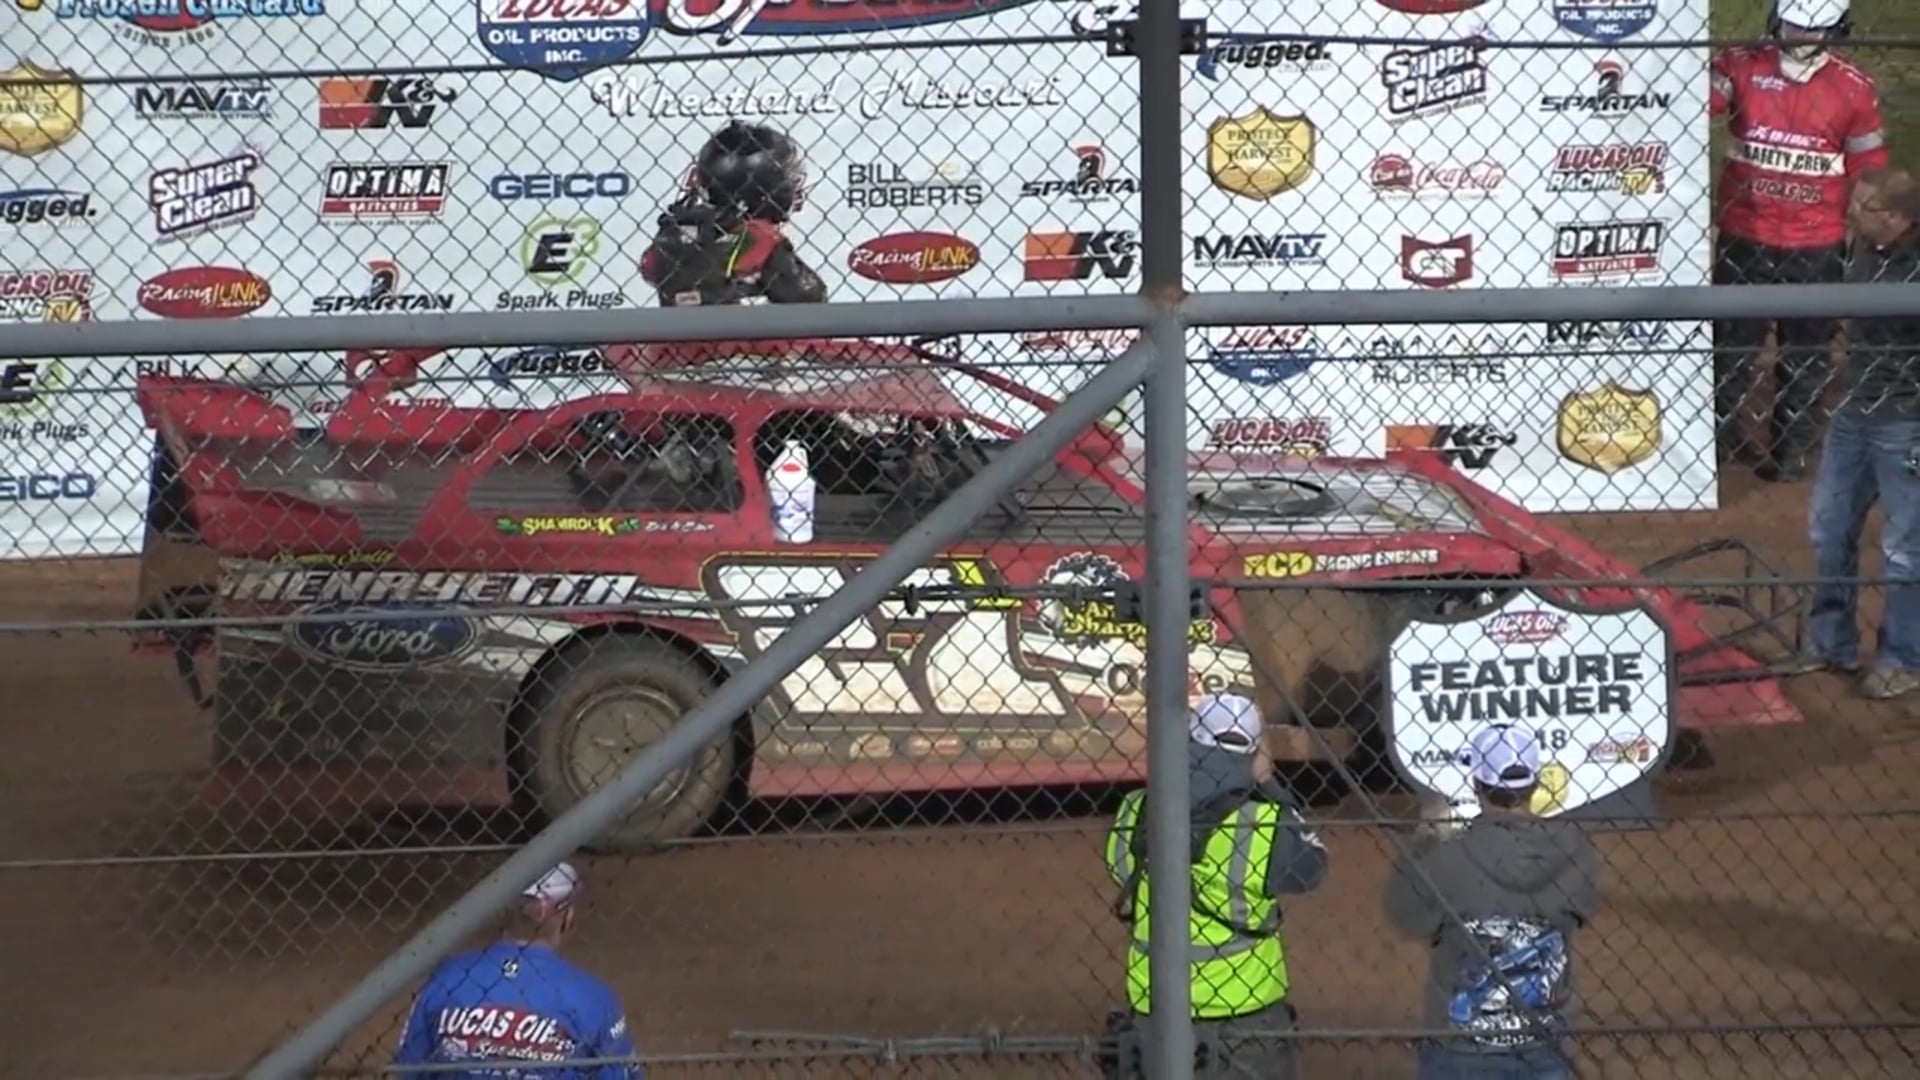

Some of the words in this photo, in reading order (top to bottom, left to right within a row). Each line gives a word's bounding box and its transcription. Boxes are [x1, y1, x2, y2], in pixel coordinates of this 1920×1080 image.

[488, 29, 525, 45] OIL
[529, 26, 641, 44] PRODUCTS
[544, 49, 589, 63] INC.
[590, 73, 842, 119] Wheatland
[861, 67, 1066, 120] Missouri
[1392, 68, 1484, 109] Clean
[1539, 93, 1672, 113] SPARTAN
[1557, 145, 1631, 171] LUCAS
[1629, 142, 1667, 166] OIL
[1745, 145, 1791, 167] SAFETY
[1793, 151, 1832, 172] CREW
[152, 157, 253, 204] Super
[328, 168, 443, 195] OPTIMA
[490, 172, 631, 199] GEICO
[847, 163, 909, 184] BILL
[1546, 171, 1625, 193] RACING
[847, 185, 983, 208] ROBERTS
[1019, 178, 1142, 198] SPARTA
[0, 194, 97, 223] gged.
[160, 185, 253, 229] Clean
[1559, 225, 1659, 256] OPTIMA
[311, 293, 455, 313] SPARTAN
[496, 292, 559, 310] Spark
[566, 288, 625, 309] Plugs
[32, 421, 90, 442] Plugs
[1210, 418, 1290, 444] LUCAS
[0, 475, 96, 501] EICO
[328, 604, 436, 655] Ford
[1410, 653, 1644, 692] FEATURE
[1420, 685, 1633, 723] WINNER
[438, 1007, 516, 1038] LUCAS
[513, 1014, 560, 1044] OIL
